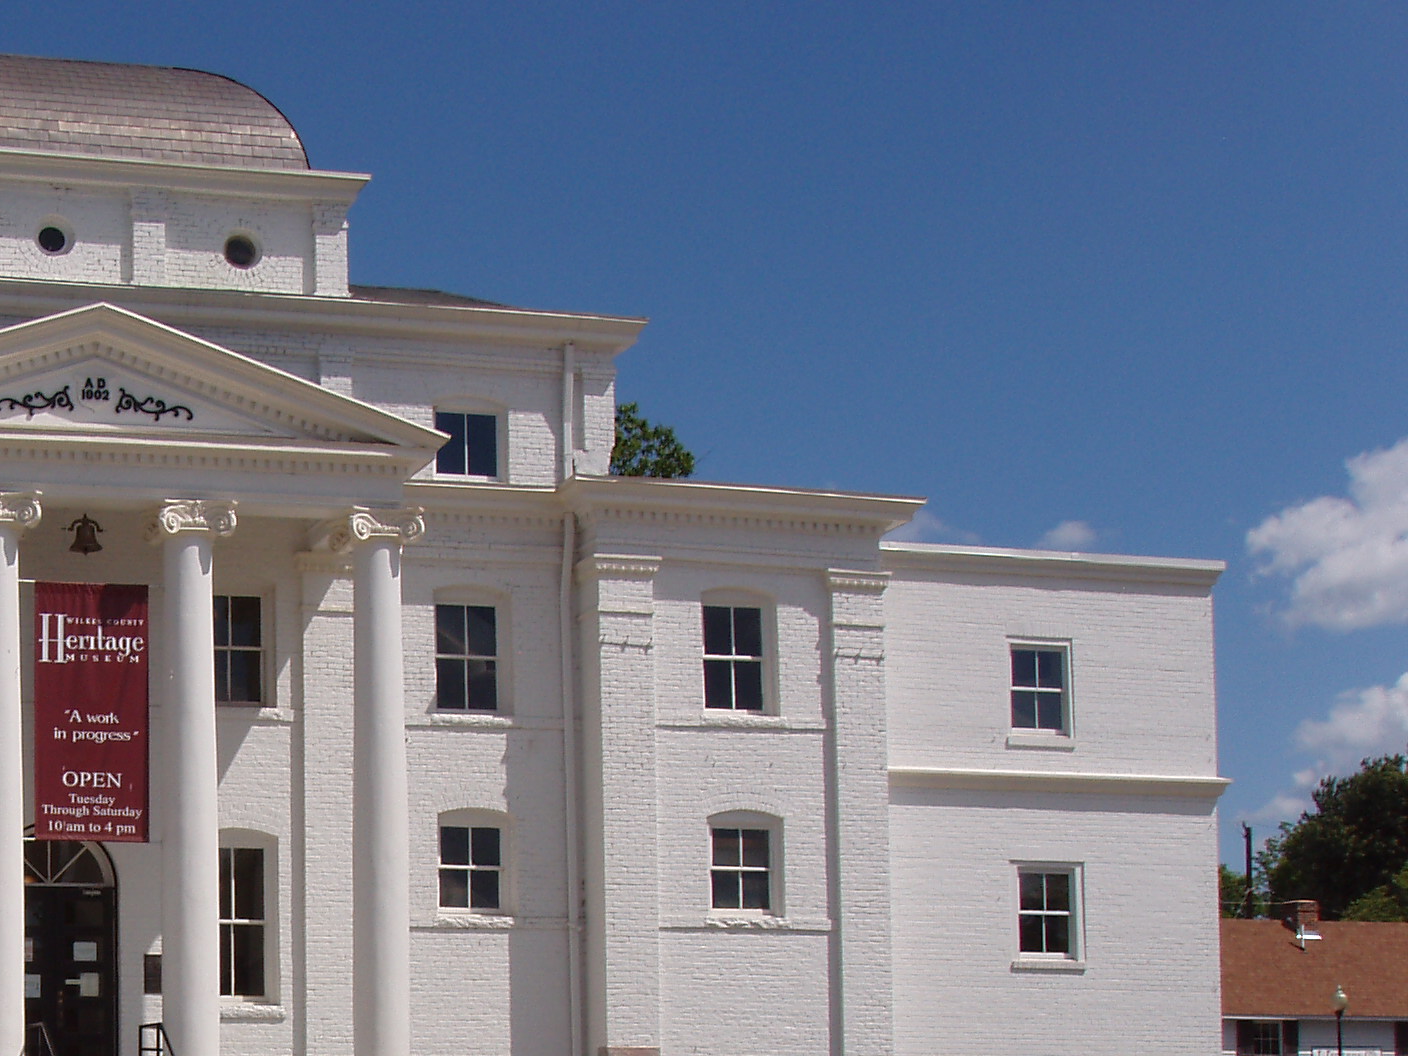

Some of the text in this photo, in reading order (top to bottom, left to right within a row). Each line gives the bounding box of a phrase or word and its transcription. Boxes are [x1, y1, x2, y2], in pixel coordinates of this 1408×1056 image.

[106, 618, 144, 626] COUNTY
[38, 613, 144, 664] Heritage
[65, 653, 140, 663] MUSEUM
[86, 712, 120, 724] work
[53, 727, 67, 739] in
[62, 771, 122, 789] OPEN
[68, 793, 116, 807] Tuesday
[41, 804, 142, 819] Through Saturday
[48, 820, 136, 836] 10 am to 4 pm
